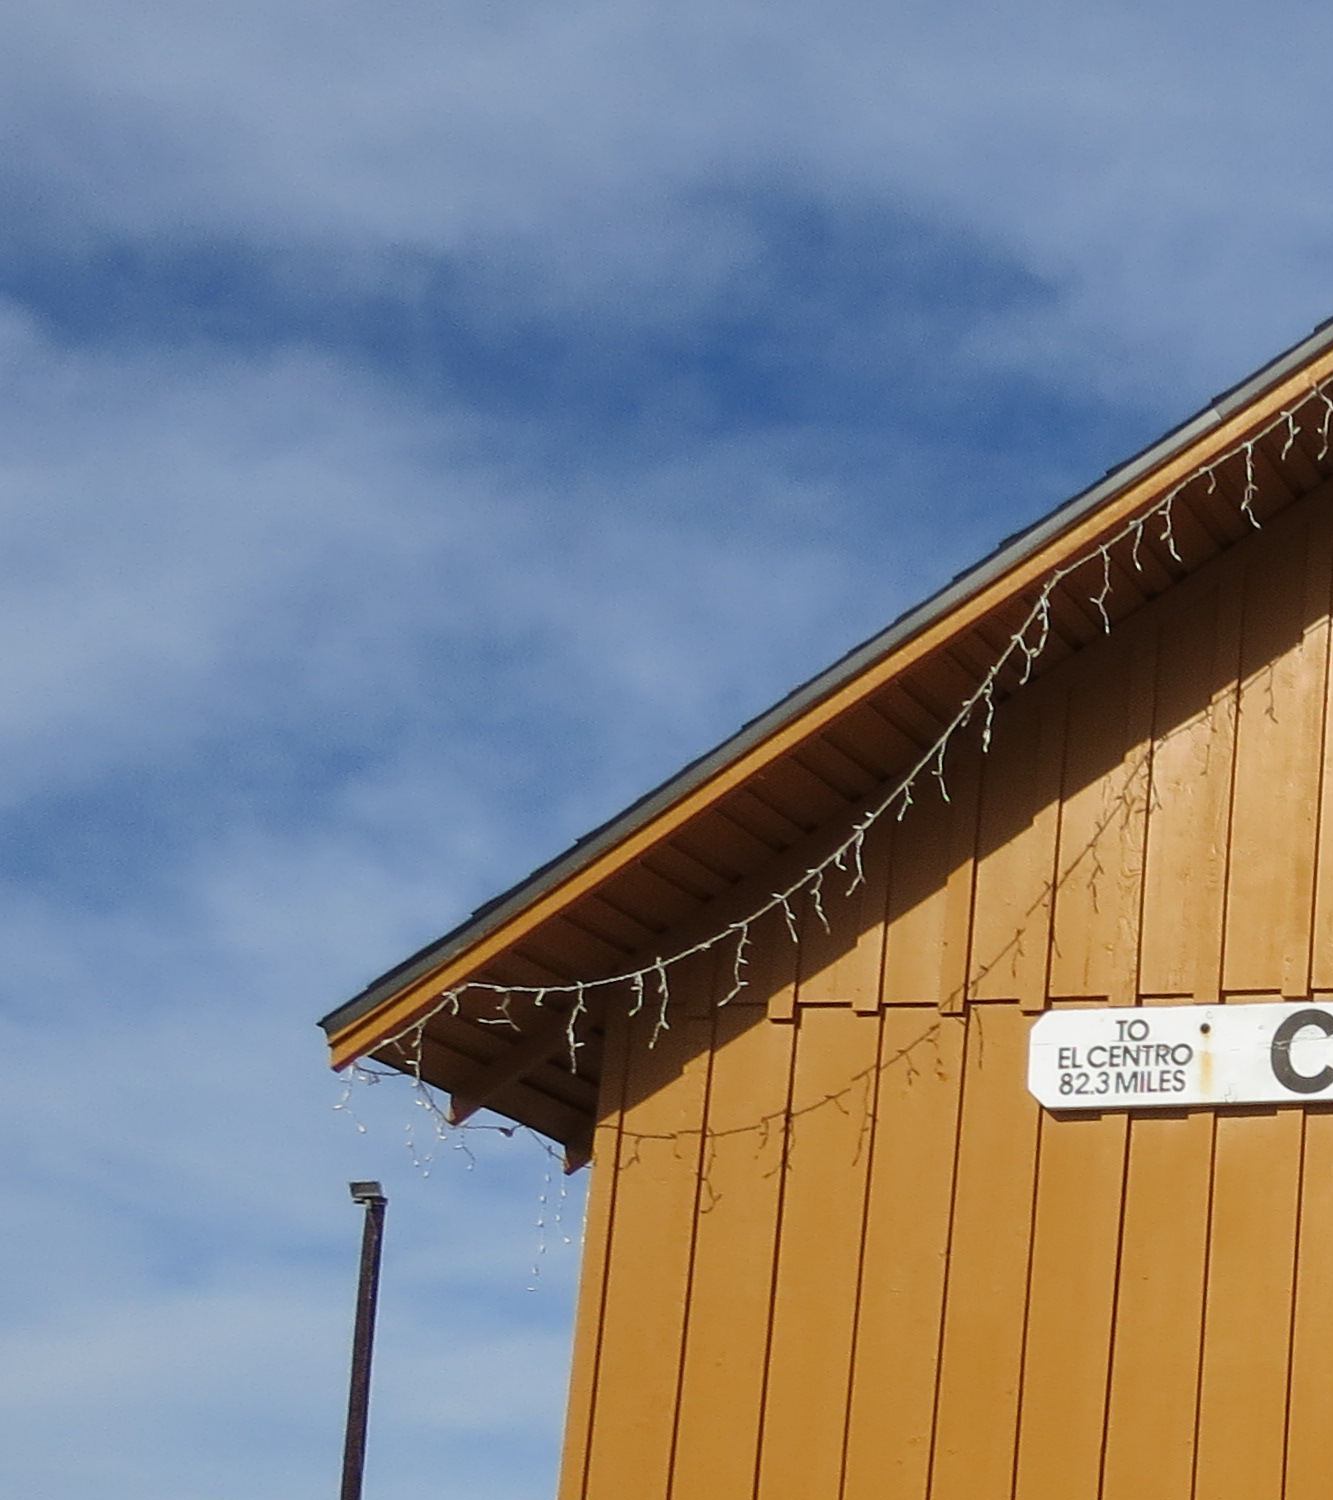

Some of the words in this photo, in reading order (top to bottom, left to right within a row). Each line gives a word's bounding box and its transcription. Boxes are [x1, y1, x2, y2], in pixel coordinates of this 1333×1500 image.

[1116, 1019, 1149, 1042] TO
[1058, 1046, 1083, 1070] EL
[1087, 1044, 1193, 1068] CENTRO
[1059, 1071, 1110, 1096] 82.3
[1115, 1070, 1185, 1094] MILES
